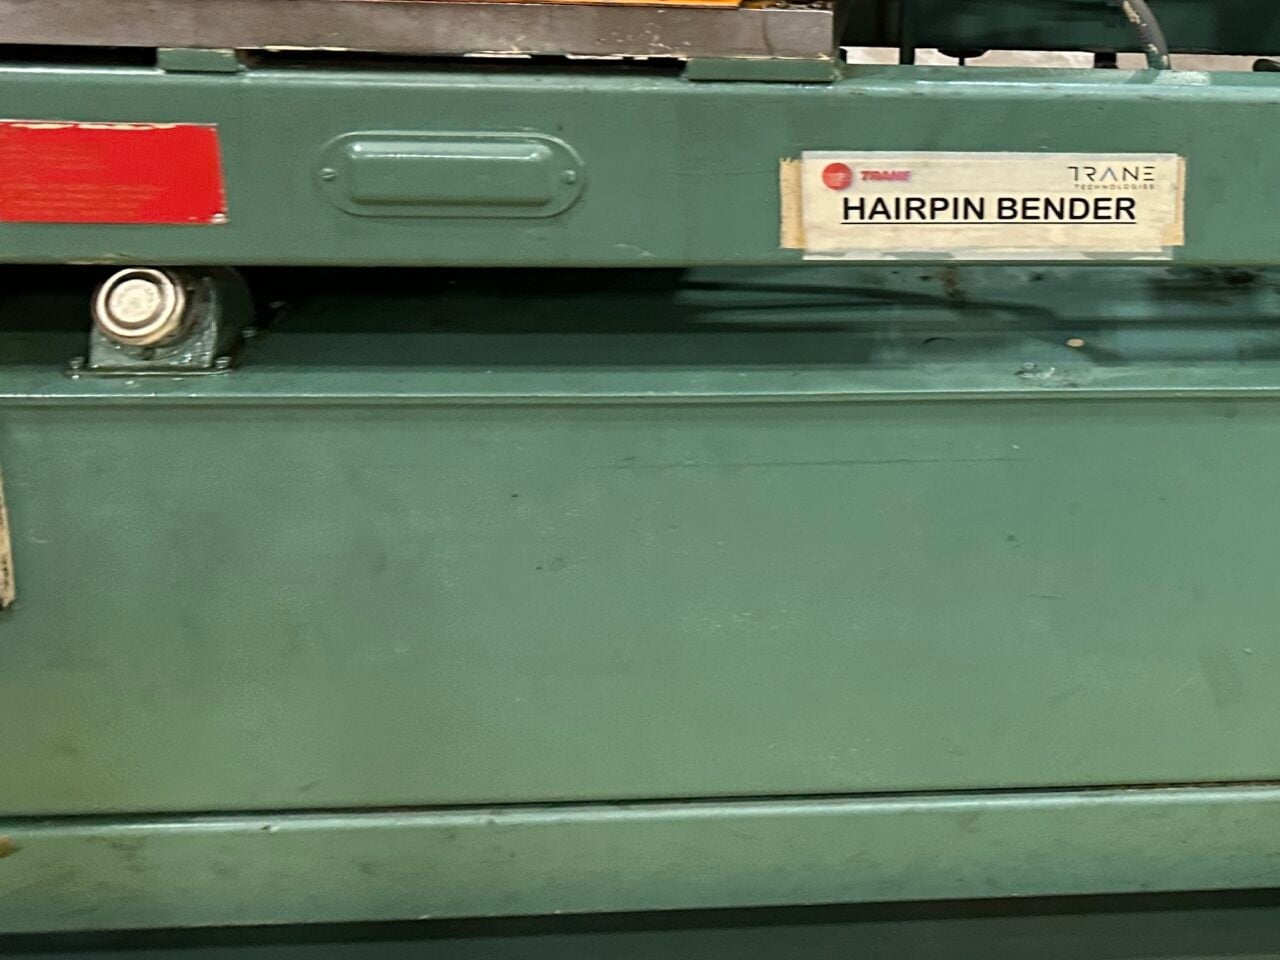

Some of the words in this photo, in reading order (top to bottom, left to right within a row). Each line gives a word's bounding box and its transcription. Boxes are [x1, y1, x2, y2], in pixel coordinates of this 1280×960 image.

[1067, 165, 1156, 182] TRANE
[1074, 183, 1155, 191] TECHNOLOGIES
[842, 196, 986, 221] HAIRPIN
[998, 196, 1138, 221] BENDER
